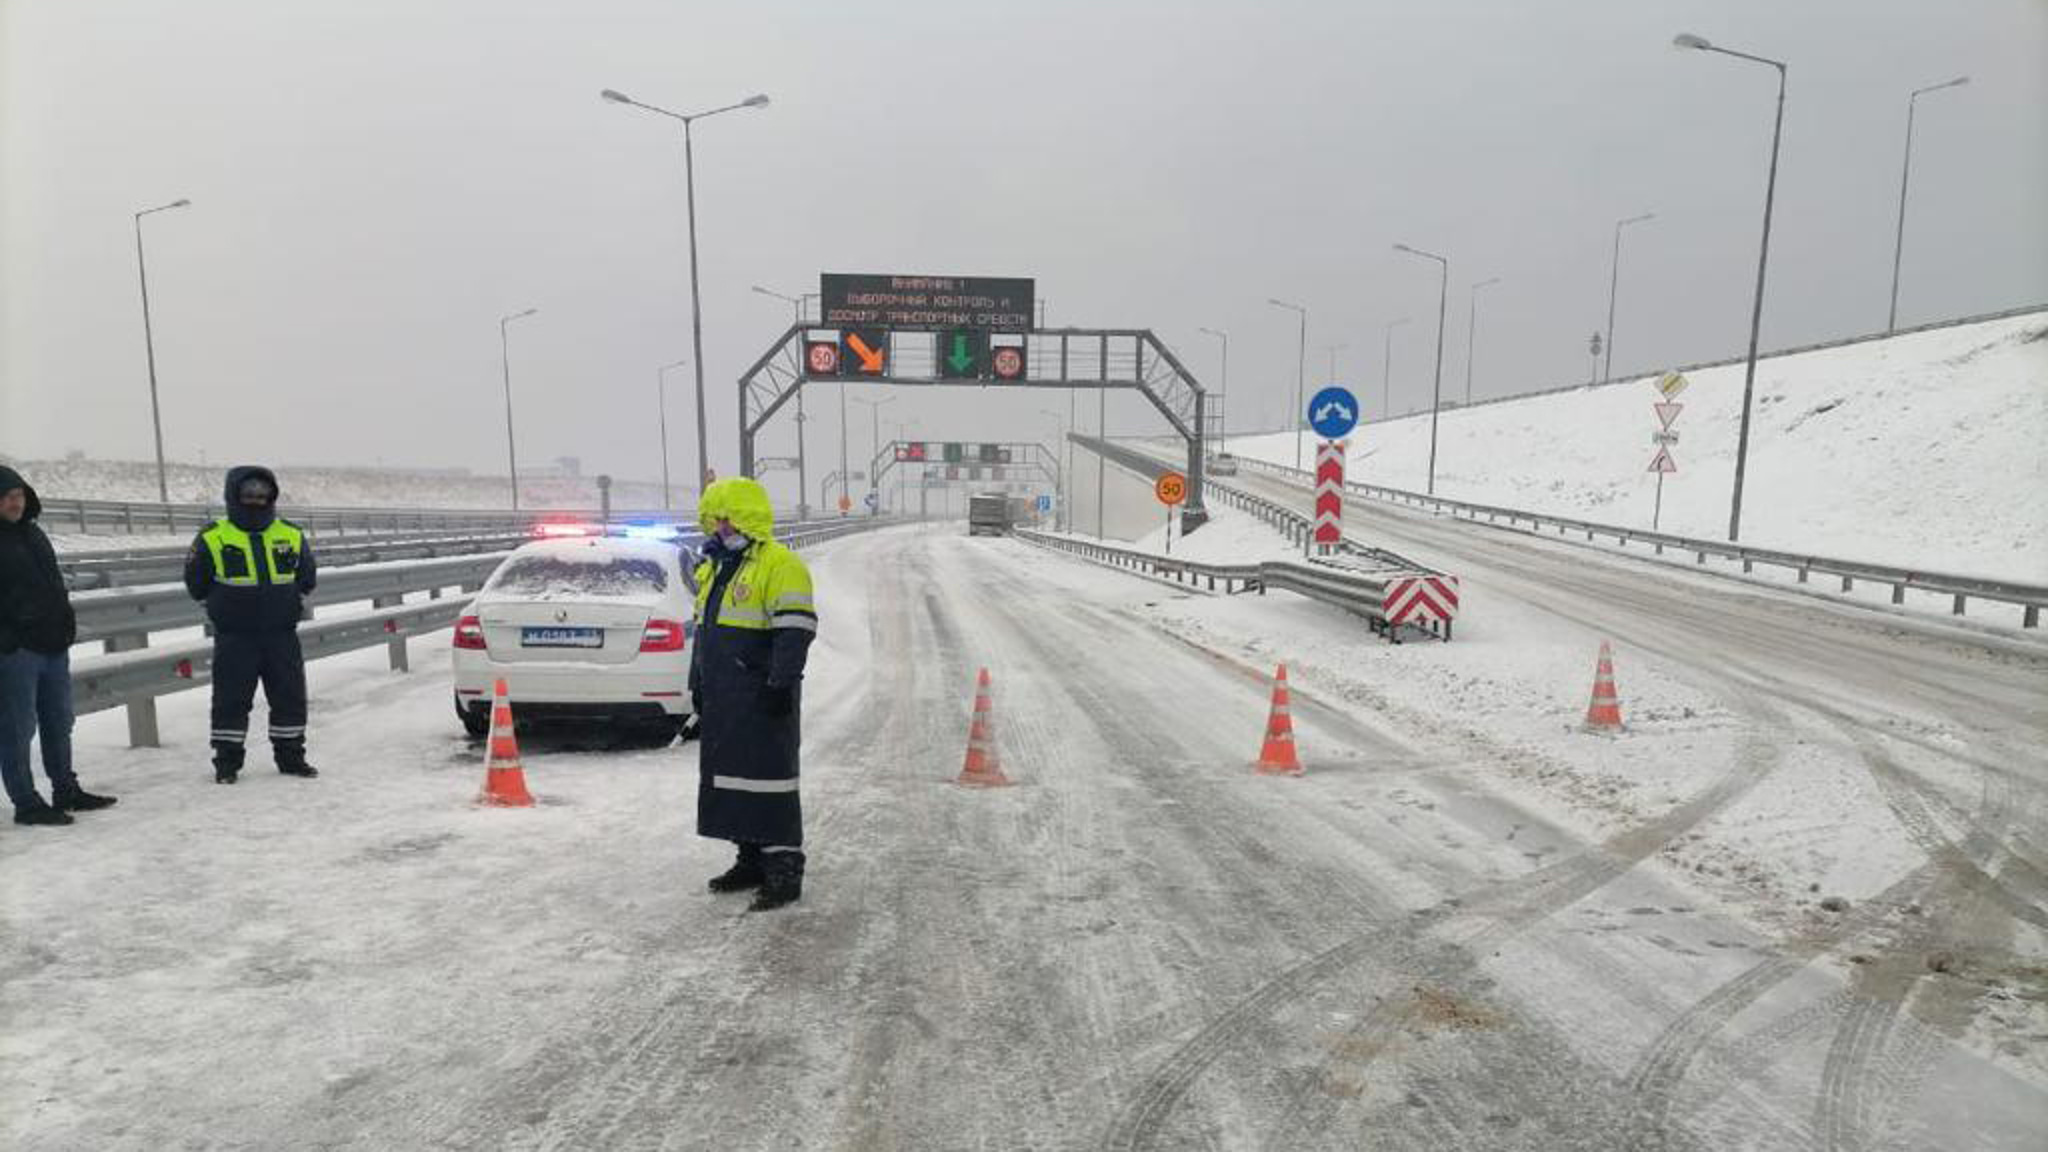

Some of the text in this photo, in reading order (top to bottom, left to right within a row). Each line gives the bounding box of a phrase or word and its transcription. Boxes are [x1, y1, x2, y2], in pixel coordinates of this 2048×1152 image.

[847, 293, 1010, 308] ВЫБОРОЧНЫЙ КОНТРОЛЬ И
[827, 309, 1029, 325] ДОСМОТР ТРАНСПОРТНЫХ СРЕДСТВ
[814, 350, 831, 365] 50
[999, 354, 1017, 370] 50
[1162, 482, 1181, 496] 50
